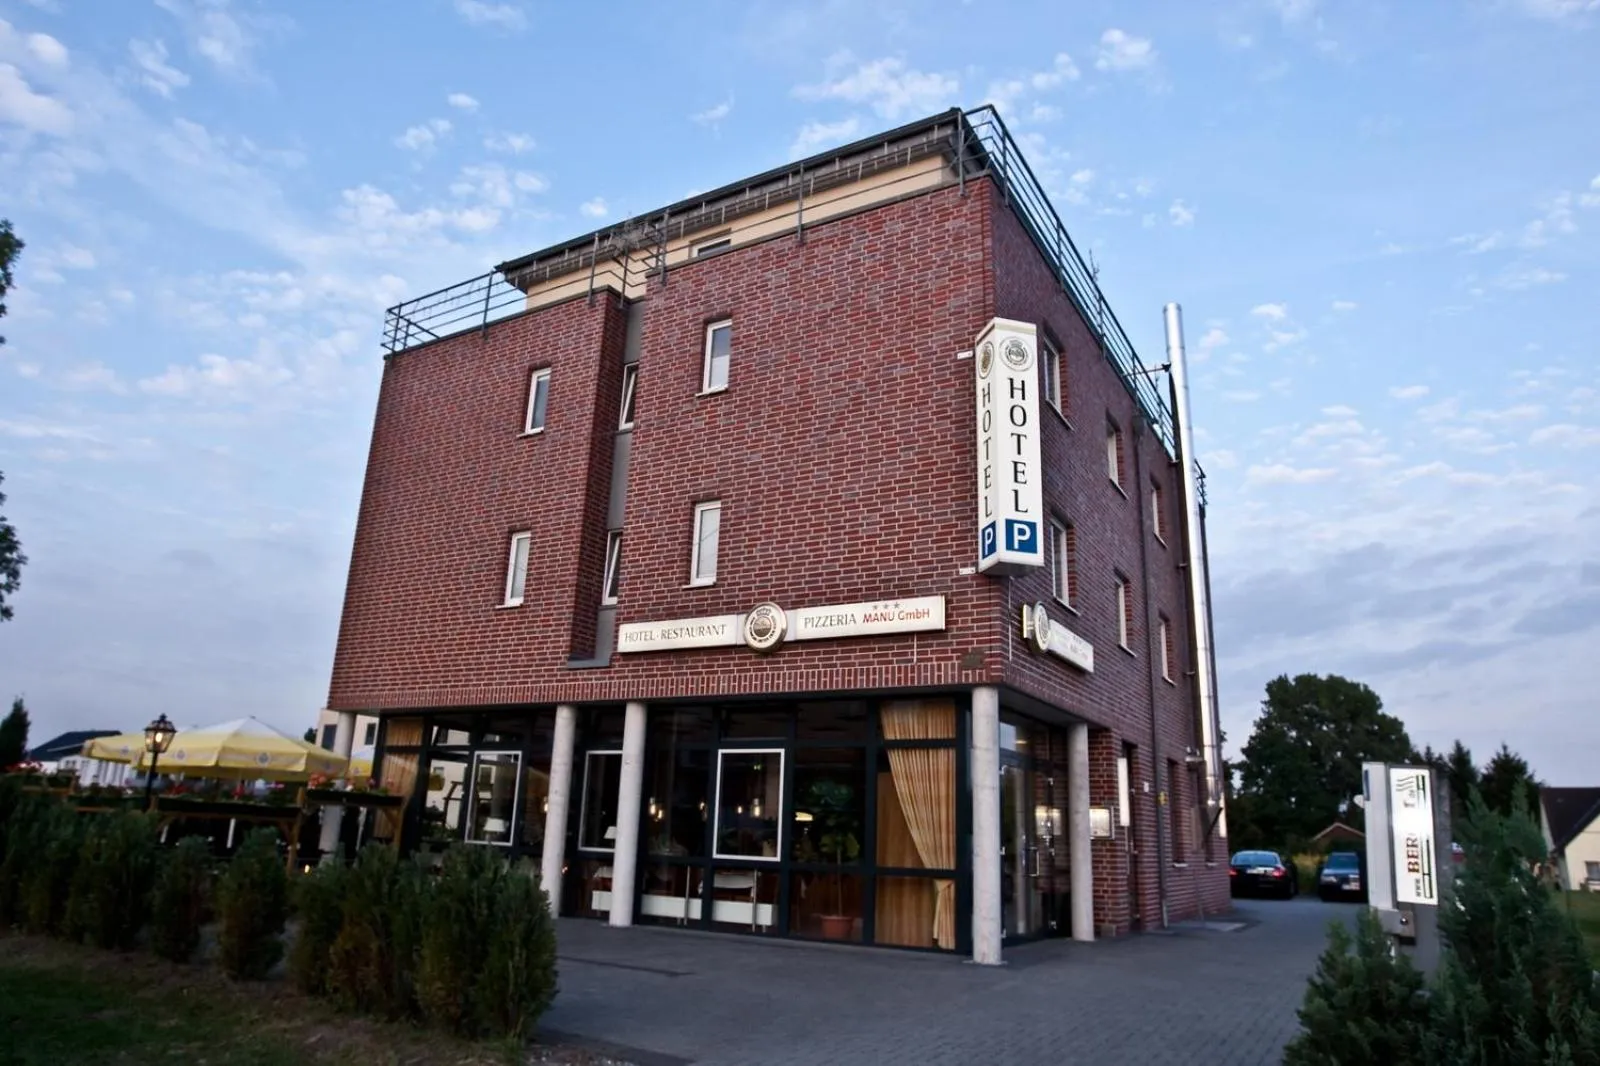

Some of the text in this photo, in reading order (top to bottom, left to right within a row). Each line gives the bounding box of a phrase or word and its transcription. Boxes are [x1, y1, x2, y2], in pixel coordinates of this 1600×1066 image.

[981, 382, 992, 518] HOTEL
[1008, 377, 1028, 514] HOTEL
[804, 613, 857, 628] PIZZERIA
[862, 612, 895, 624] MANU
[897, 608, 930, 621] GmbH
